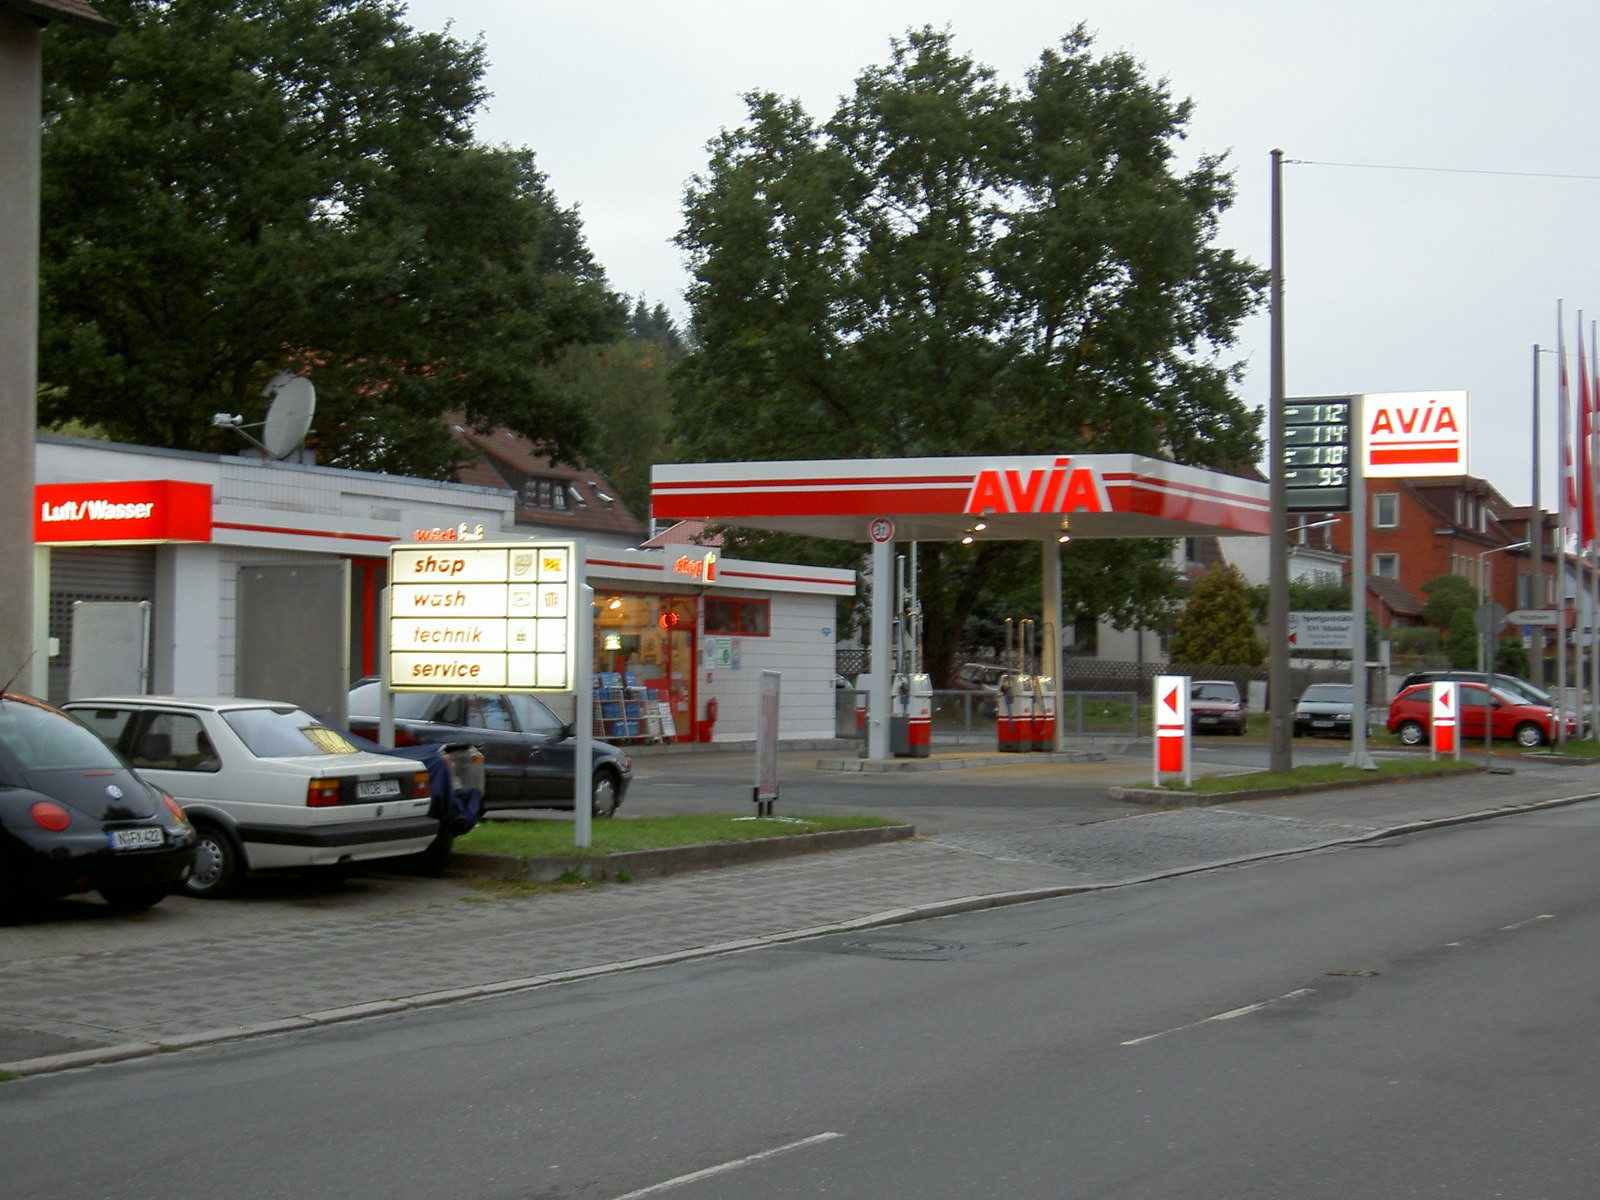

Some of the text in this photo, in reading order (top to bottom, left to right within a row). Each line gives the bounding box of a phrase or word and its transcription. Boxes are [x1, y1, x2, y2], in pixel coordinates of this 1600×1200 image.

[1370, 399, 1459, 435] AVIA
[967, 457, 1103, 514] AVIA
[415, 555, 465, 577] shop
[414, 590, 466, 607] wash
[413, 627, 482, 643] technik
[412, 660, 481, 677] service
